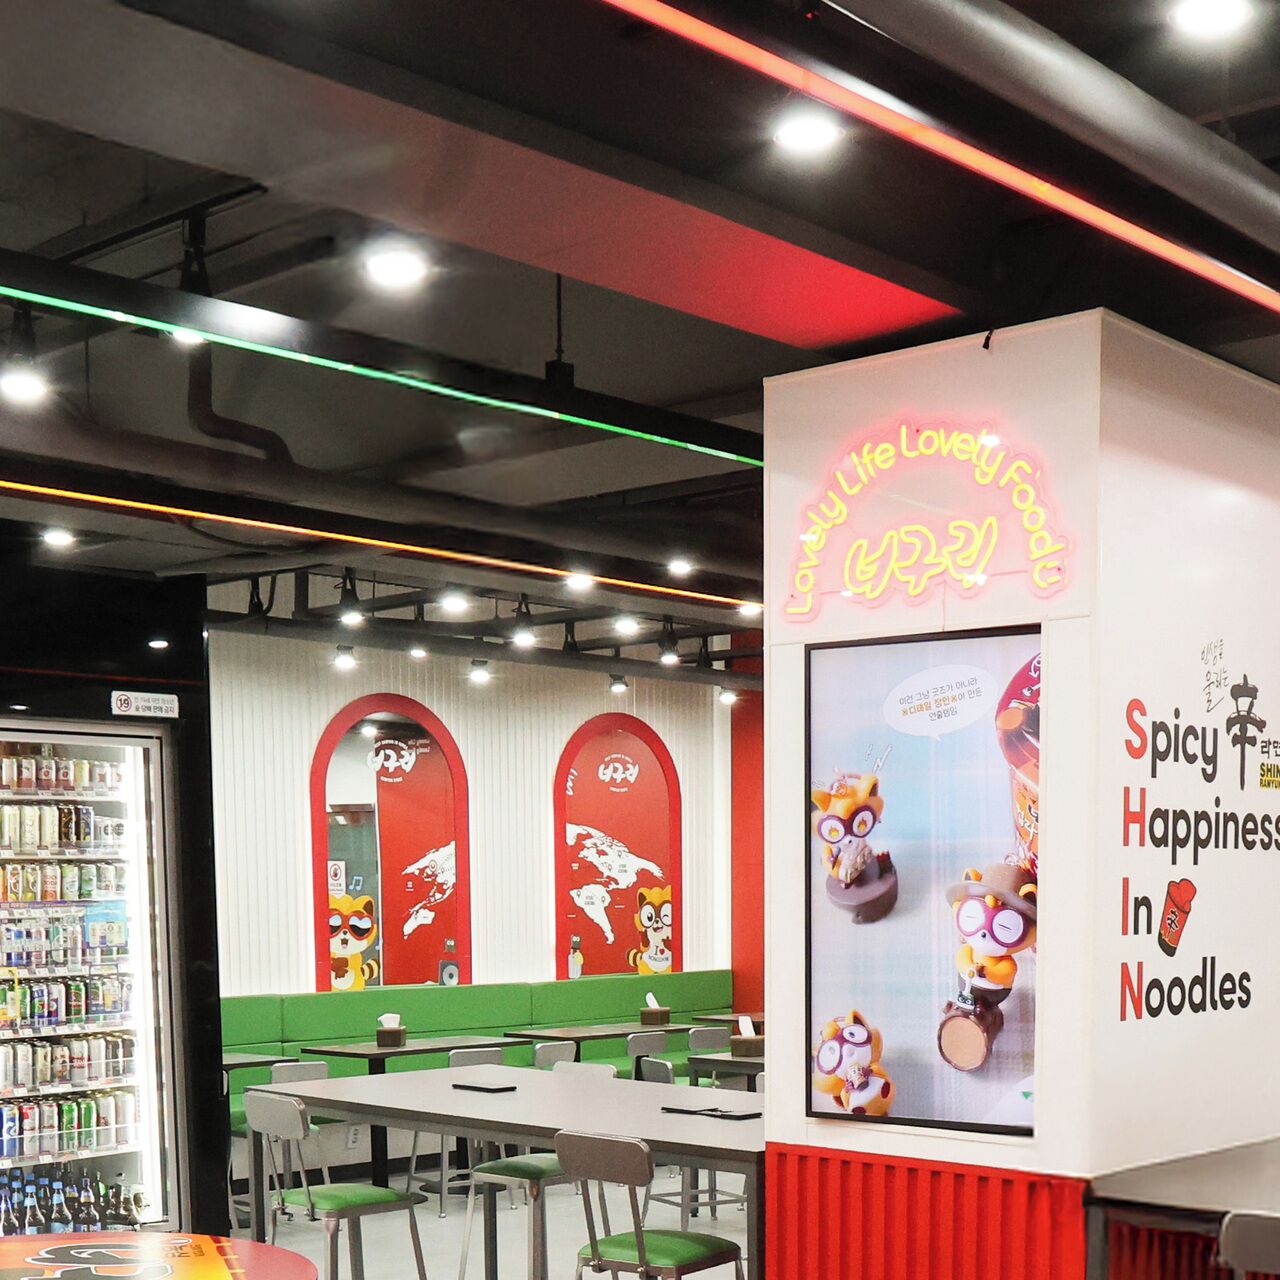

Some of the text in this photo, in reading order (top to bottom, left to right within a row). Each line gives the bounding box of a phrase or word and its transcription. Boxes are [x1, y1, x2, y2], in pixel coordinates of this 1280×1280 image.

[787, 490, 848, 614] Lovely
[900, 425, 1002, 484] Lovely
[999, 459, 1063, 573] Food
[844, 516, 998, 599] 너구리
[1125, 698, 1218, 783] Spicy
[1226, 674, 1266, 790] 辛
[1121, 877, 1152, 936] In
[1120, 956, 1251, 1021] Noodles
